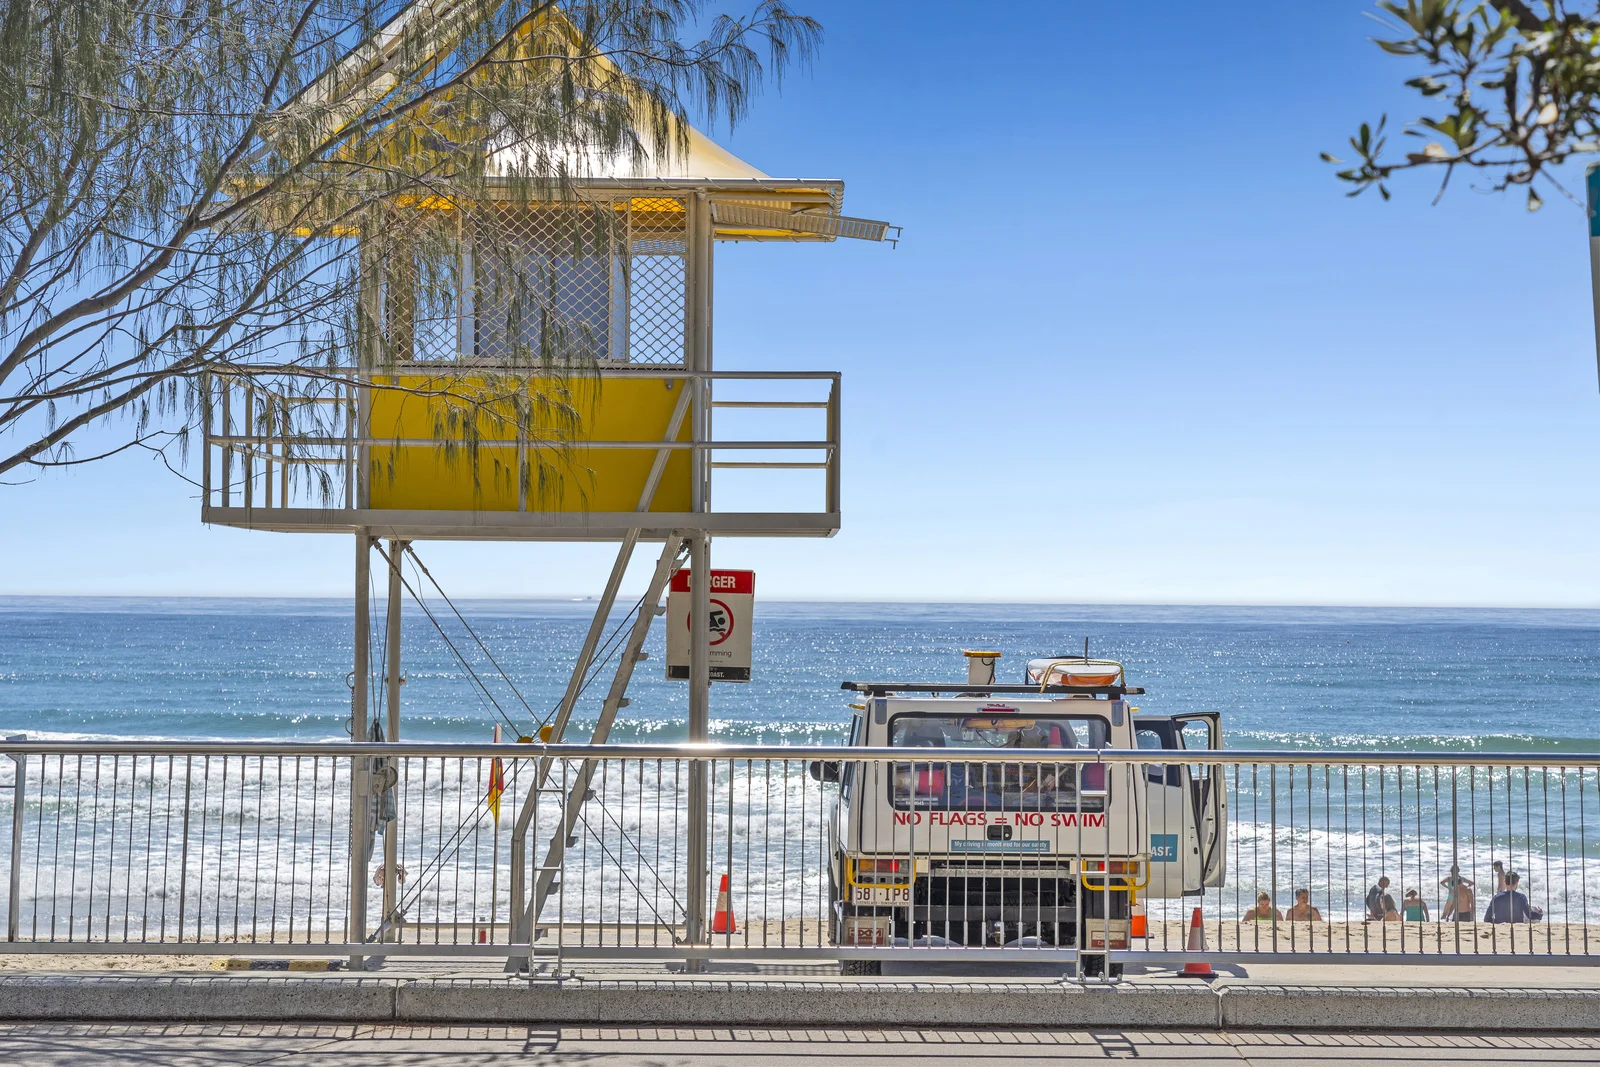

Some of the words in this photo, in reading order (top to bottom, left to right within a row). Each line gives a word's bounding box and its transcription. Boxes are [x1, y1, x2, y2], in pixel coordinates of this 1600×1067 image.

[893, 812, 922, 826] NO
[930, 812, 988, 826] FLAGS
[1015, 812, 1044, 827] NO
[1051, 814, 1105, 827] SWIM
